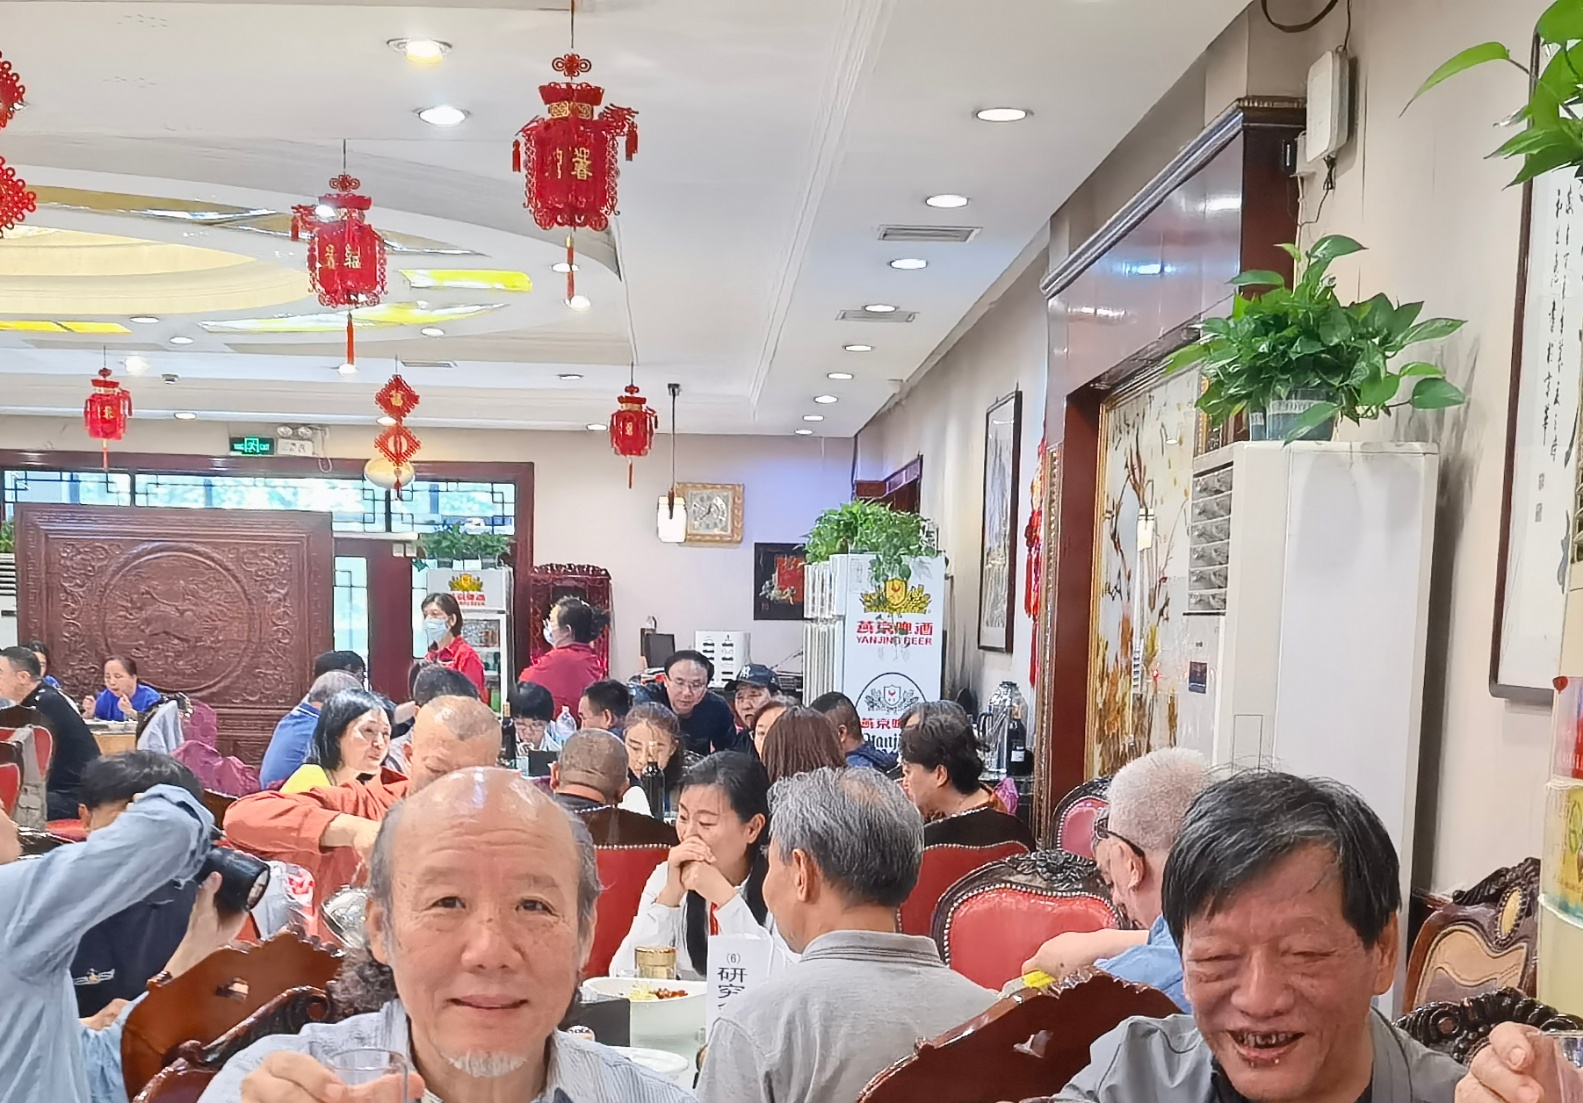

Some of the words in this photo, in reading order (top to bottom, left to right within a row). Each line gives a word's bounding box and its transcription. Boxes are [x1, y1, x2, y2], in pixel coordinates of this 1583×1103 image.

[856, 621, 933, 636] 燕京啤酒
[717, 967, 748, 1010] 研究
